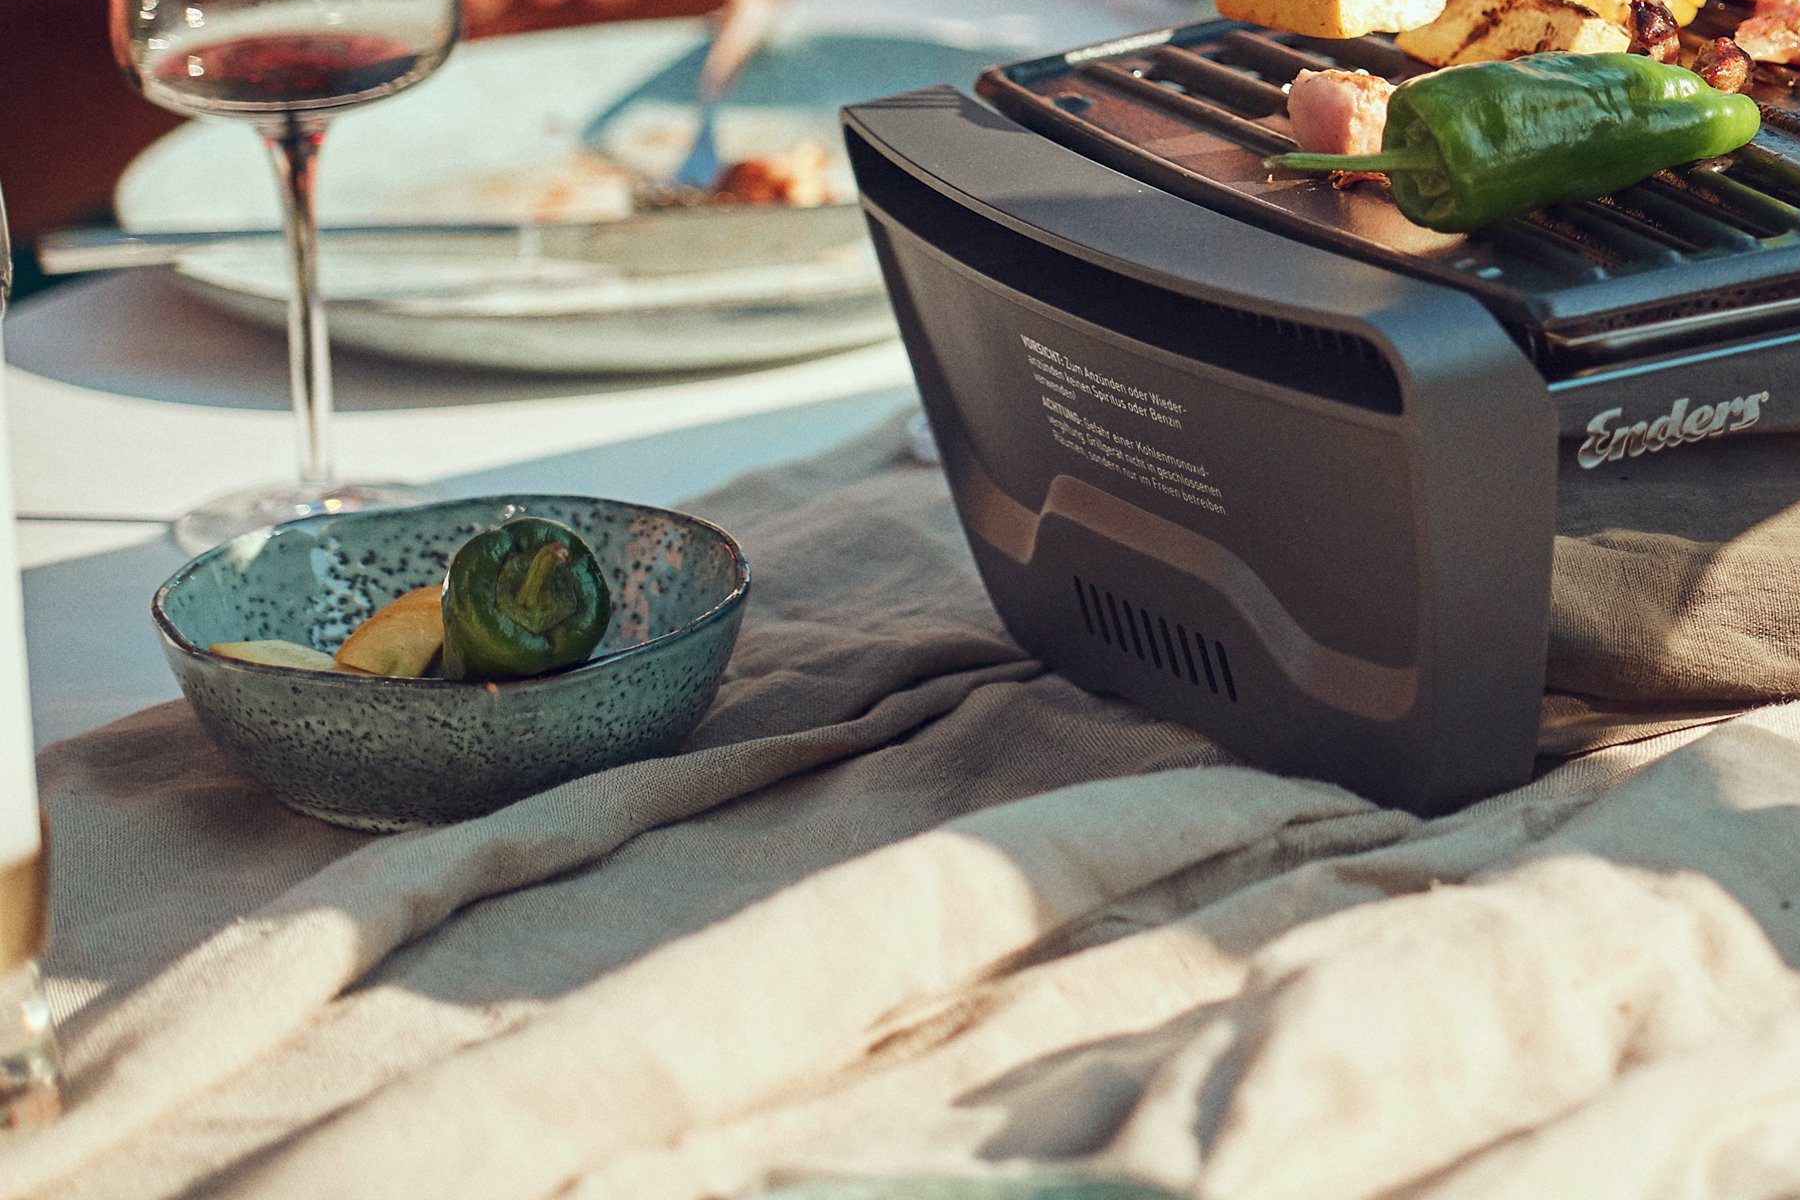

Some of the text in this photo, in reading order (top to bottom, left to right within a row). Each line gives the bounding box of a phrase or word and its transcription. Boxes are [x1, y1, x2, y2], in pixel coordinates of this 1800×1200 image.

[1064, 355, 1084, 375] Zum
[1083, 366, 1127, 394] Anzünden
[1127, 386, 1148, 402] oder
[1149, 391, 1187, 413] Wieder-
[1091, 384, 1127, 409] Spiritus
[1127, 402, 1148, 417] oder
[1149, 407, 1182, 429] Benzin
[1577, 390, 1770, 470] Enders
[1112, 432, 1134, 449] einer
[1135, 441, 1209, 477] Kohlenmonoxid-
[1124, 454, 1147, 471] nicht
[1146, 462, 1156, 474] in
[1156, 467, 1222, 498] geschlossenen
[1121, 467, 1137, 480] nur
[1139, 474, 1152, 488] im
[1151, 477, 1181, 499] Freien
[1180, 489, 1229, 516] betreiben.
